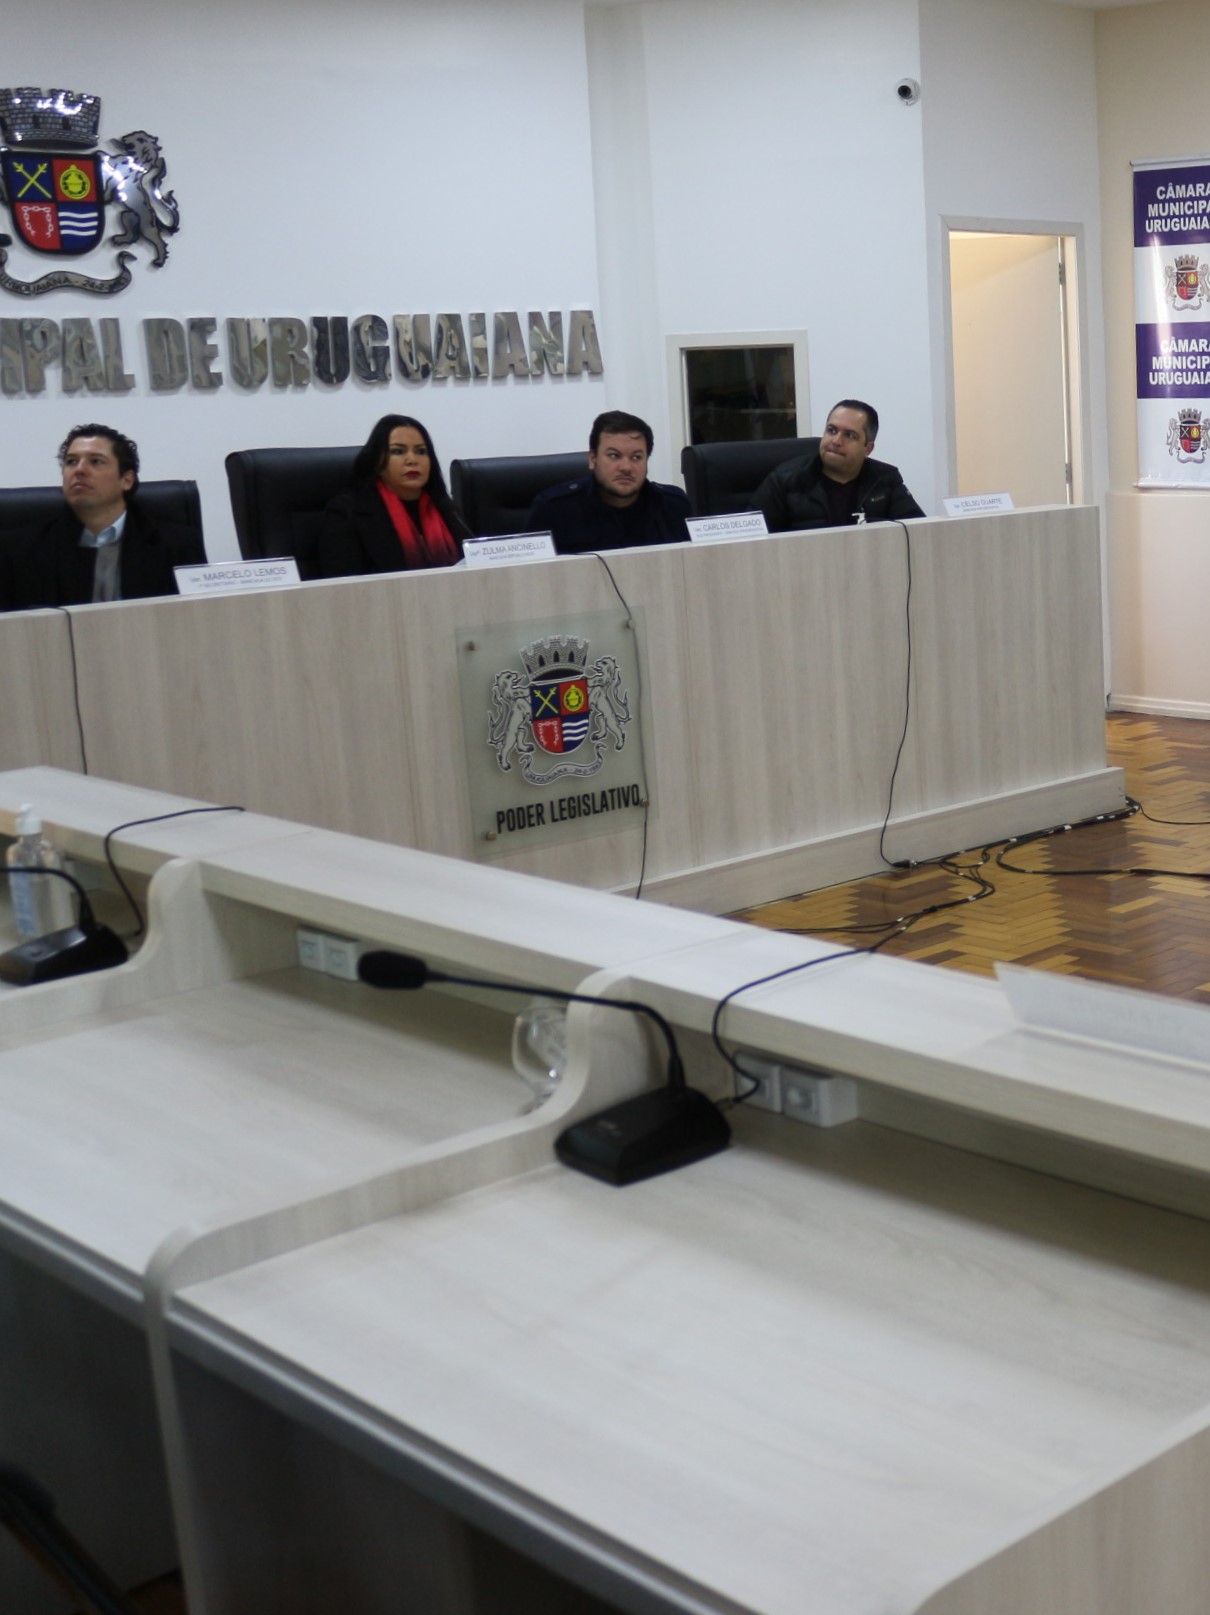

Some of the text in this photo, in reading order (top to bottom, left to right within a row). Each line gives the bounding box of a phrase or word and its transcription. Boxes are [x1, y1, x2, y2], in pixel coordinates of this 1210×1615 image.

[144, 316, 222, 392] DE
[227, 310, 604, 389] URUGUAIANA
[702, 522, 730, 532] CARLOS
[730, 519, 761, 529] DELGADO
[203, 569, 252, 581] MARCELO
[254, 566, 288, 578] LEMOS
[496, 783, 641, 834] PODER LEGISLATIVO
